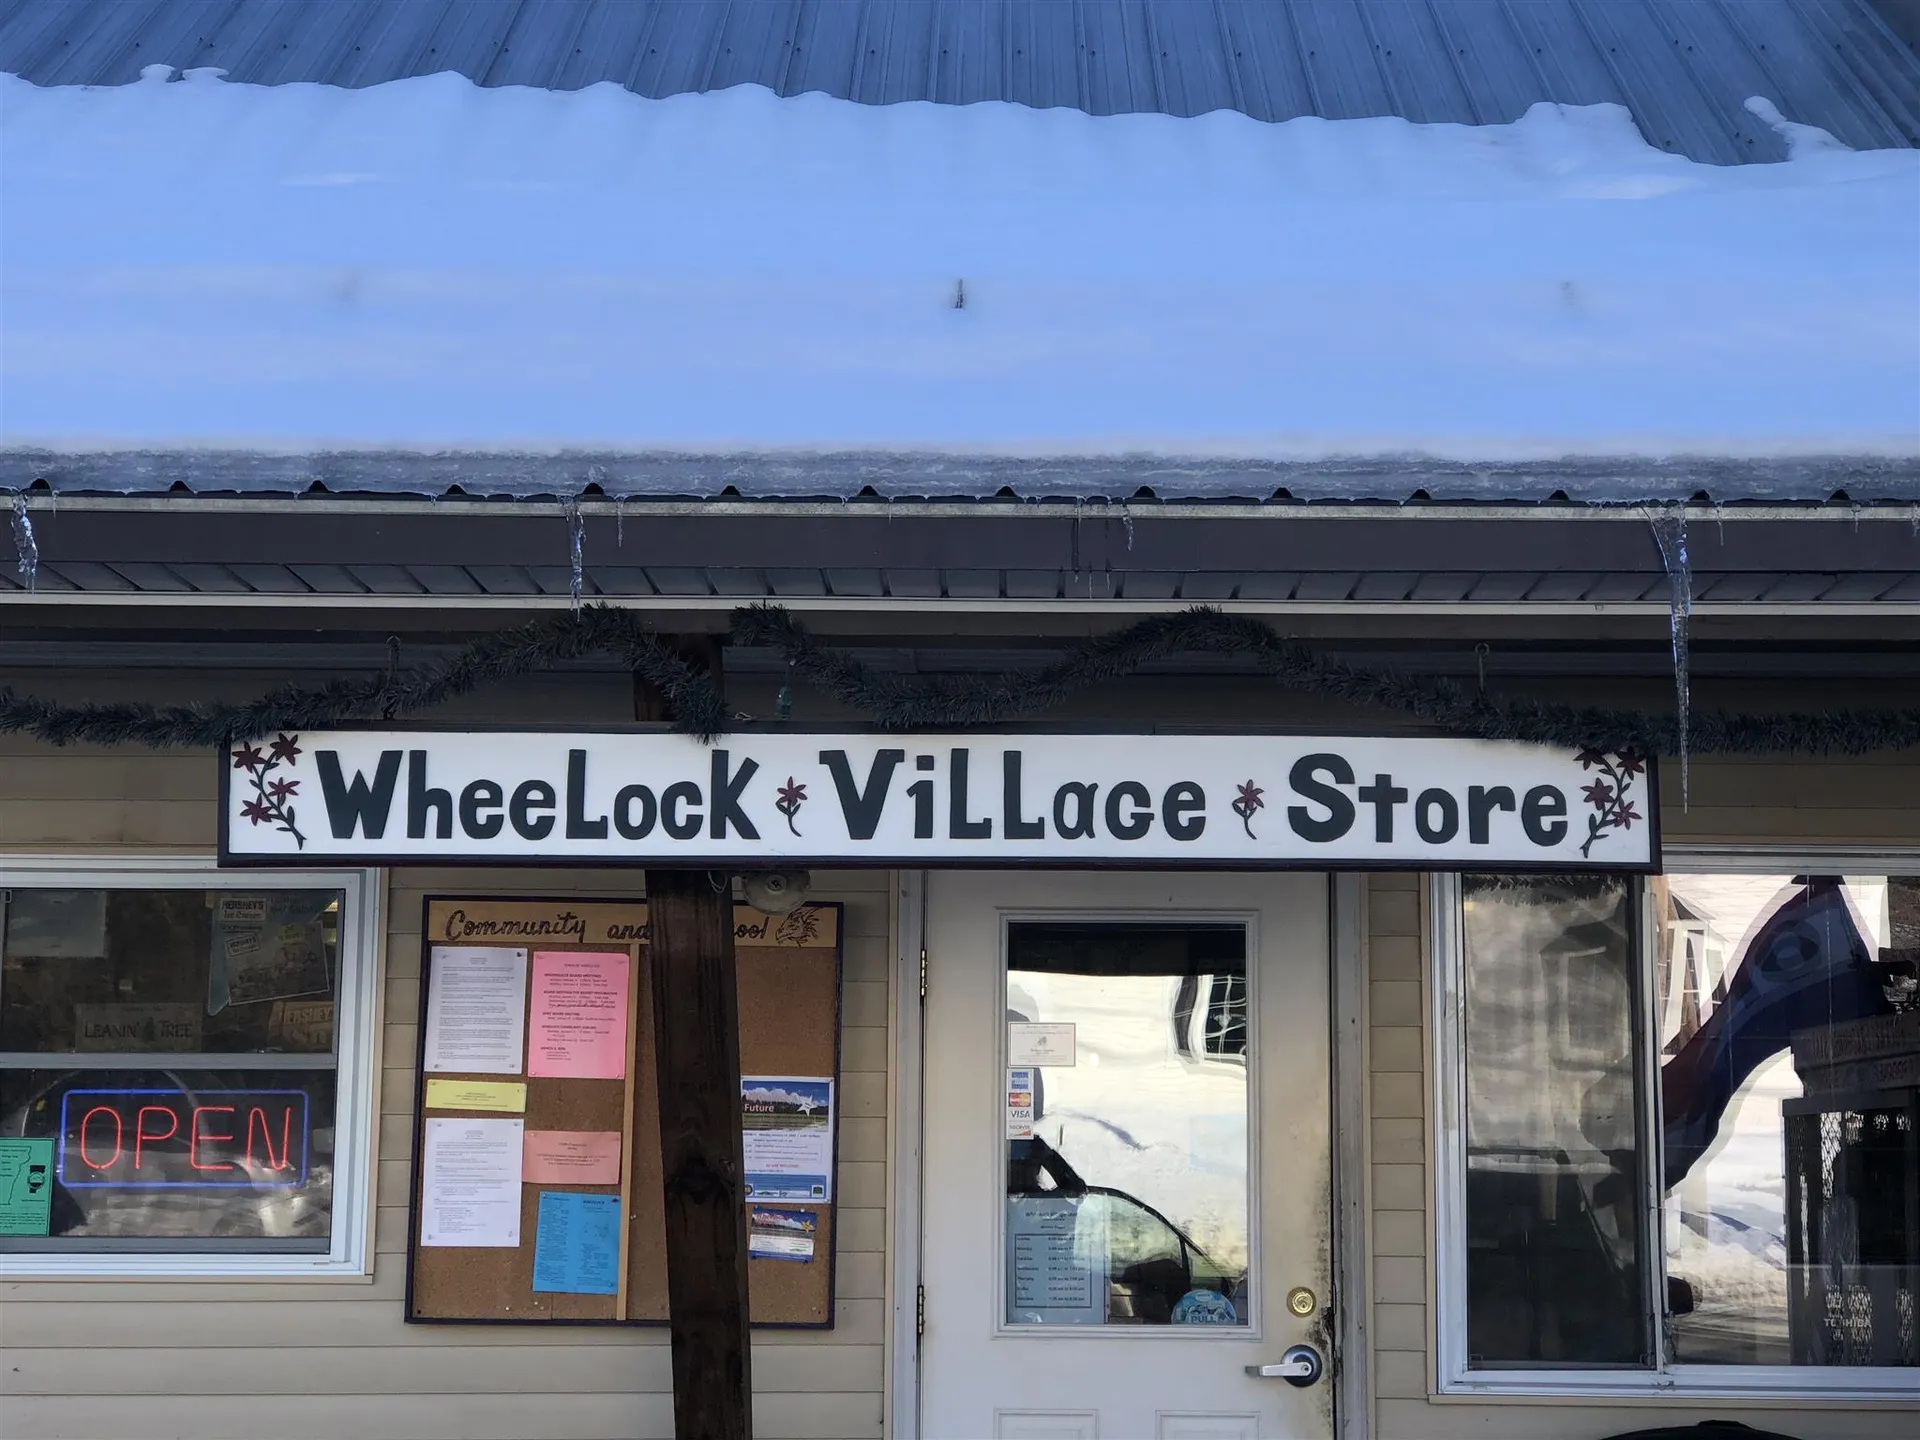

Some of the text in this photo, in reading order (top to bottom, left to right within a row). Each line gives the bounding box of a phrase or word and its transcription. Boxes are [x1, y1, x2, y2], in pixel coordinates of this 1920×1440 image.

[1288, 752, 1568, 846] Store
[445, 909, 586, 943] Community
[734, 916, 769, 939] ool
[744, 1103, 775, 1113] Future
[1011, 1110, 1031, 1119] VISA
[80, 1106, 292, 1171] OPEN
[1824, 1318, 1872, 1328] TOHIBA
